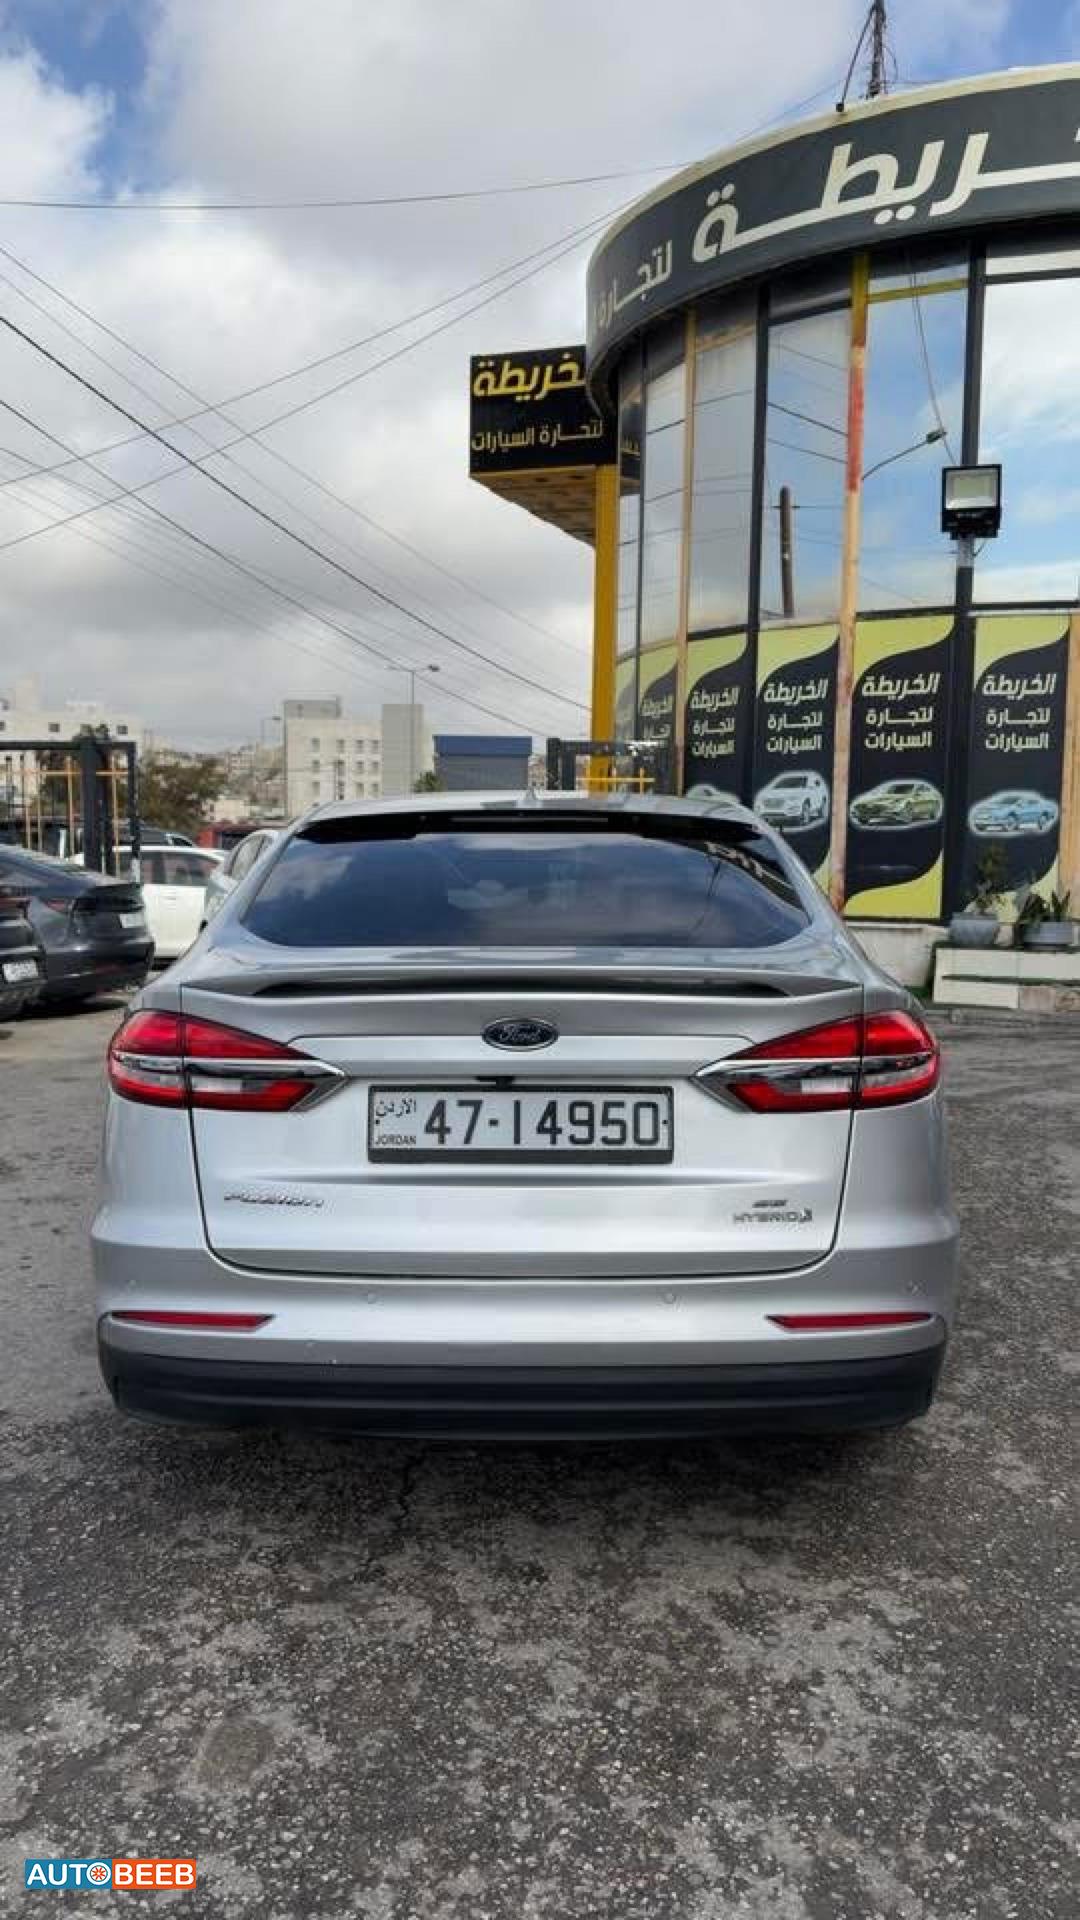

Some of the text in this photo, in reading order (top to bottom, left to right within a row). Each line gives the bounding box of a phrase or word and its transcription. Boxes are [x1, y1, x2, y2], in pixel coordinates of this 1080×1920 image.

[692, 129, 1080, 263] ريطة
[473, 352, 586, 402] خريطة
[763, 678, 829, 706] الخريطة
[862, 672, 940, 701] الخريطة
[982, 672, 1057, 701] الخريطة
[689, 685, 741, 713] الخريطة
[767, 710, 823, 733] لتجارة
[865, 706, 933, 727] لتجارة
[985, 707, 1051, 728] لتجارة
[766, 734, 823, 755] السيارات
[863, 731, 933, 752] السيارات
[984, 732, 1050, 753] السيارات
[424, 1099, 660, 1146] 47-14950
[374, 1135, 417, 1146] JORDAN
[733, 1211, 799, 1224] HYBRID
